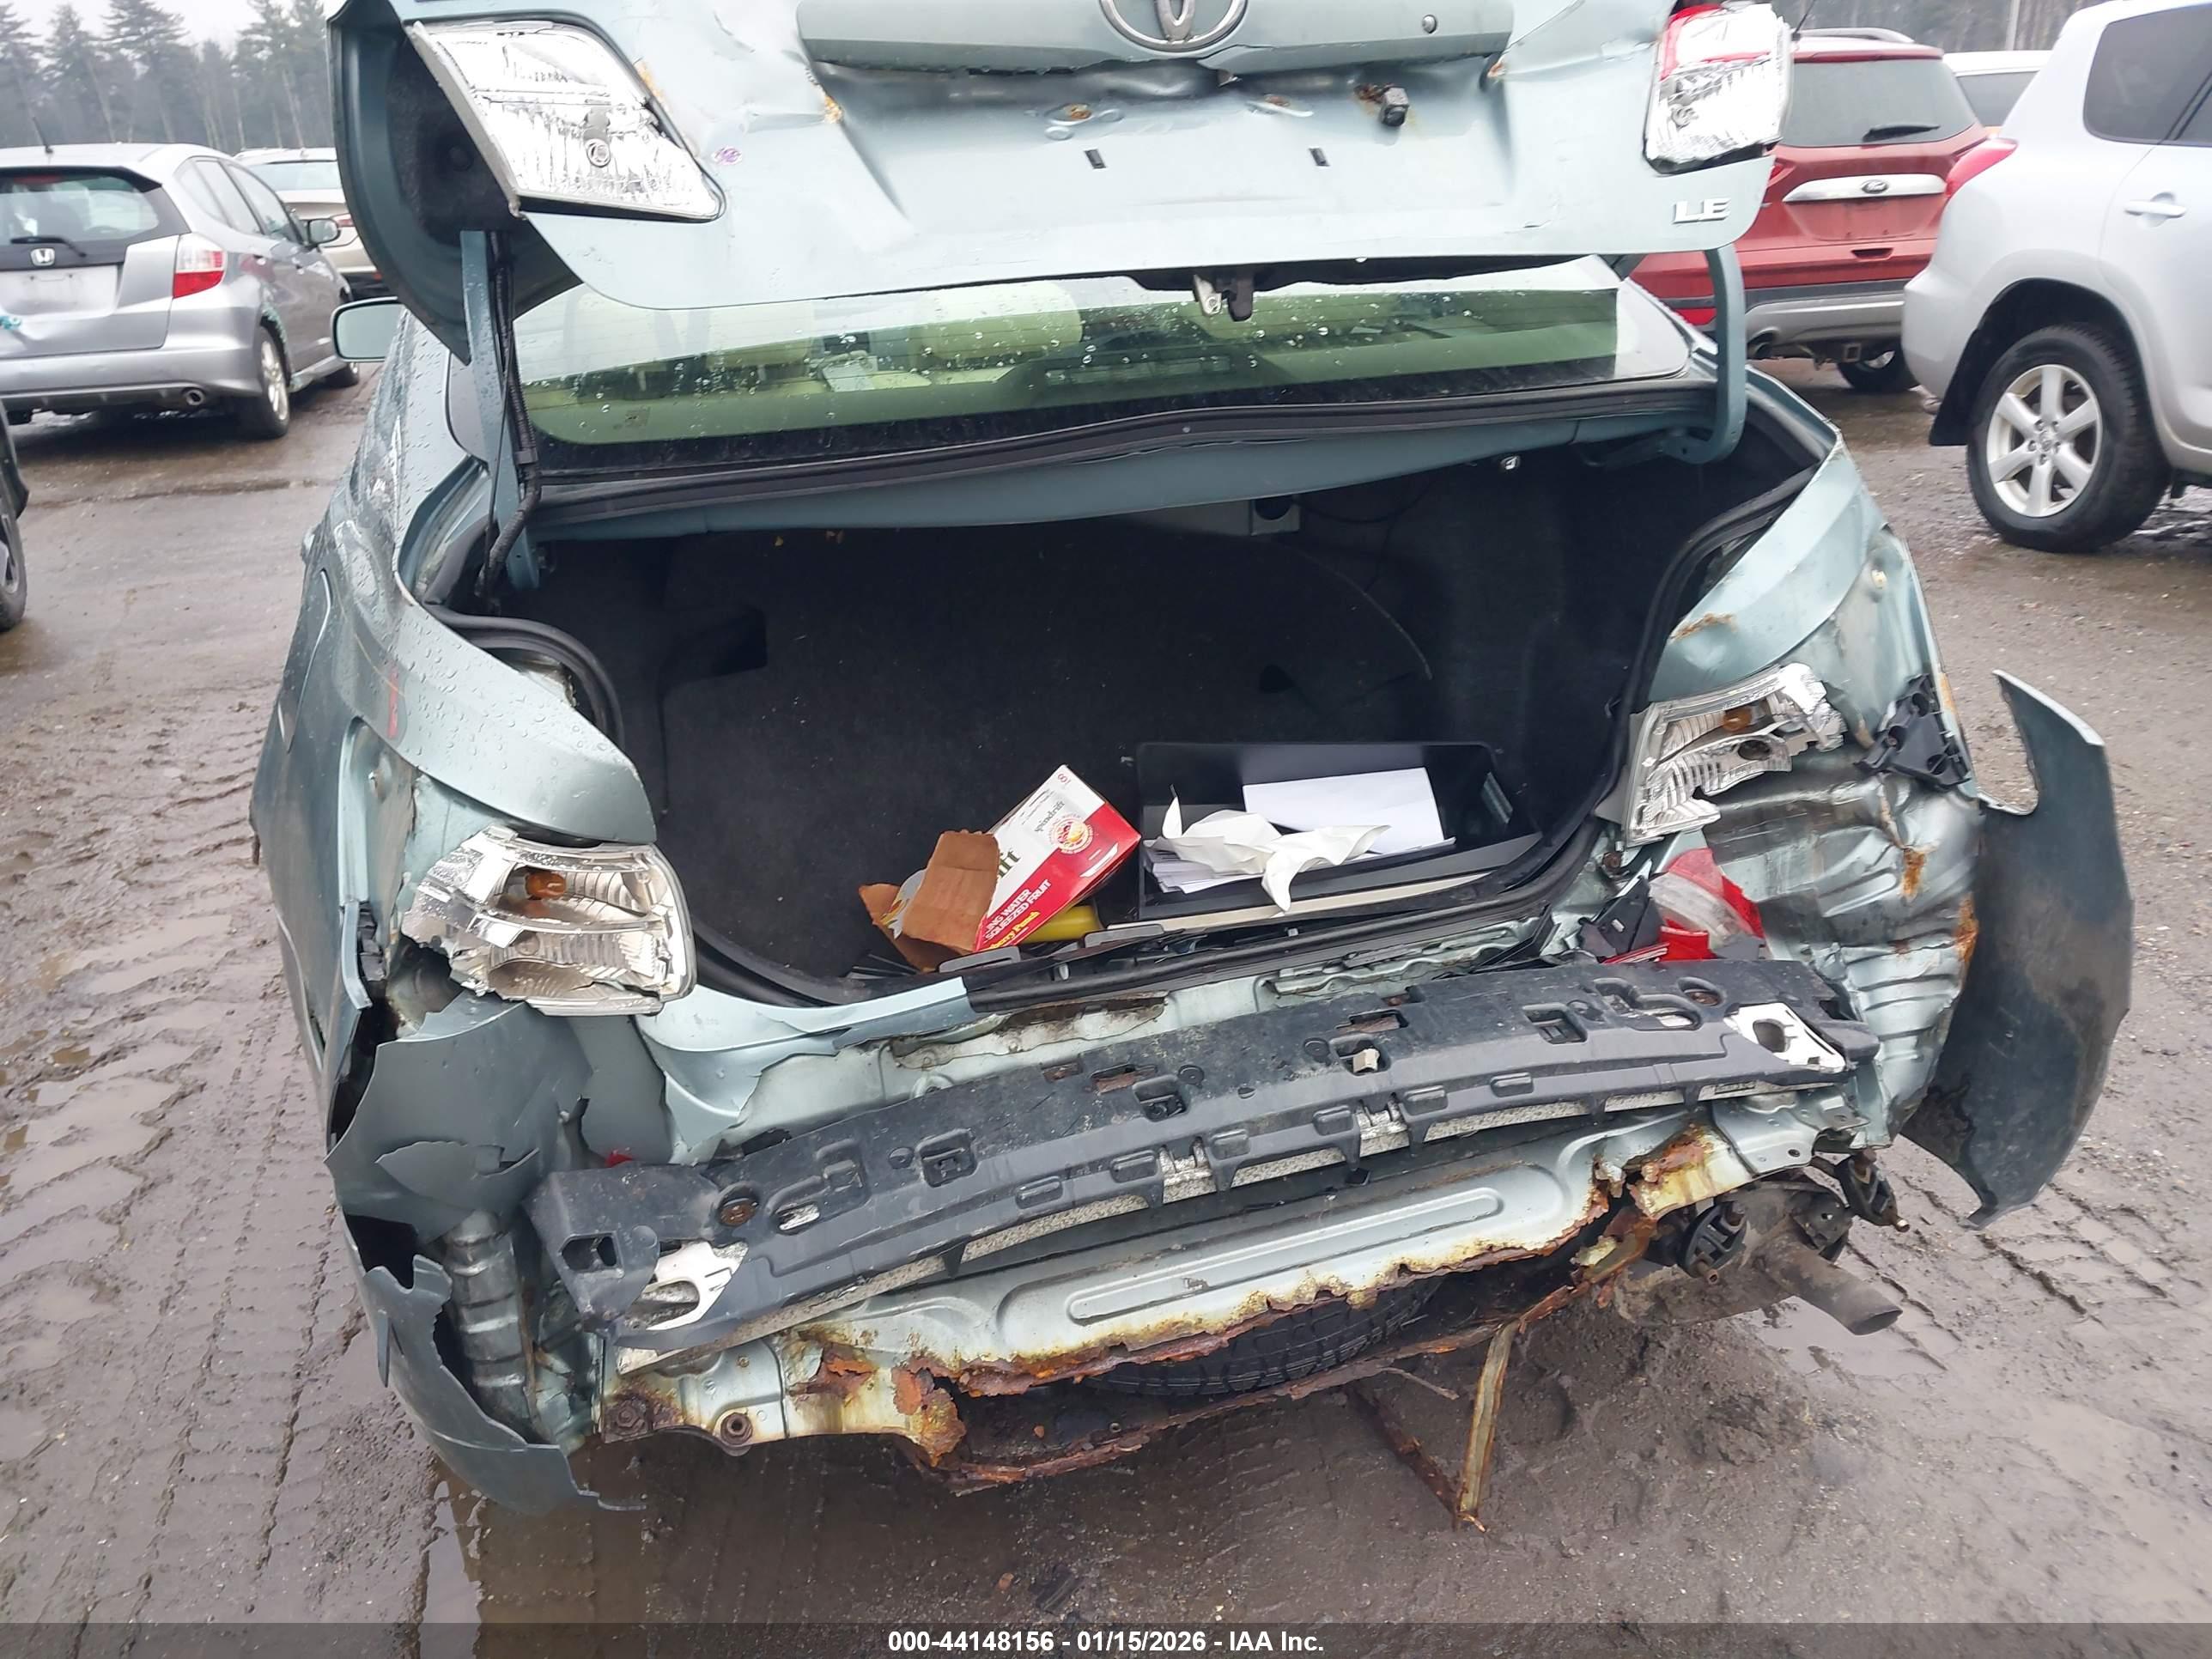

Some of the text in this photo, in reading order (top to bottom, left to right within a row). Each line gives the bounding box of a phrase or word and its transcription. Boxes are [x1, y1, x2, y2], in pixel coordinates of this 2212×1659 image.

[1673, 198, 1731, 224] LE
[985, 902, 1030, 940] SQUEEZED
[1027, 878, 1052, 905] FRUIT
[1000, 889, 1032, 917] WATER
